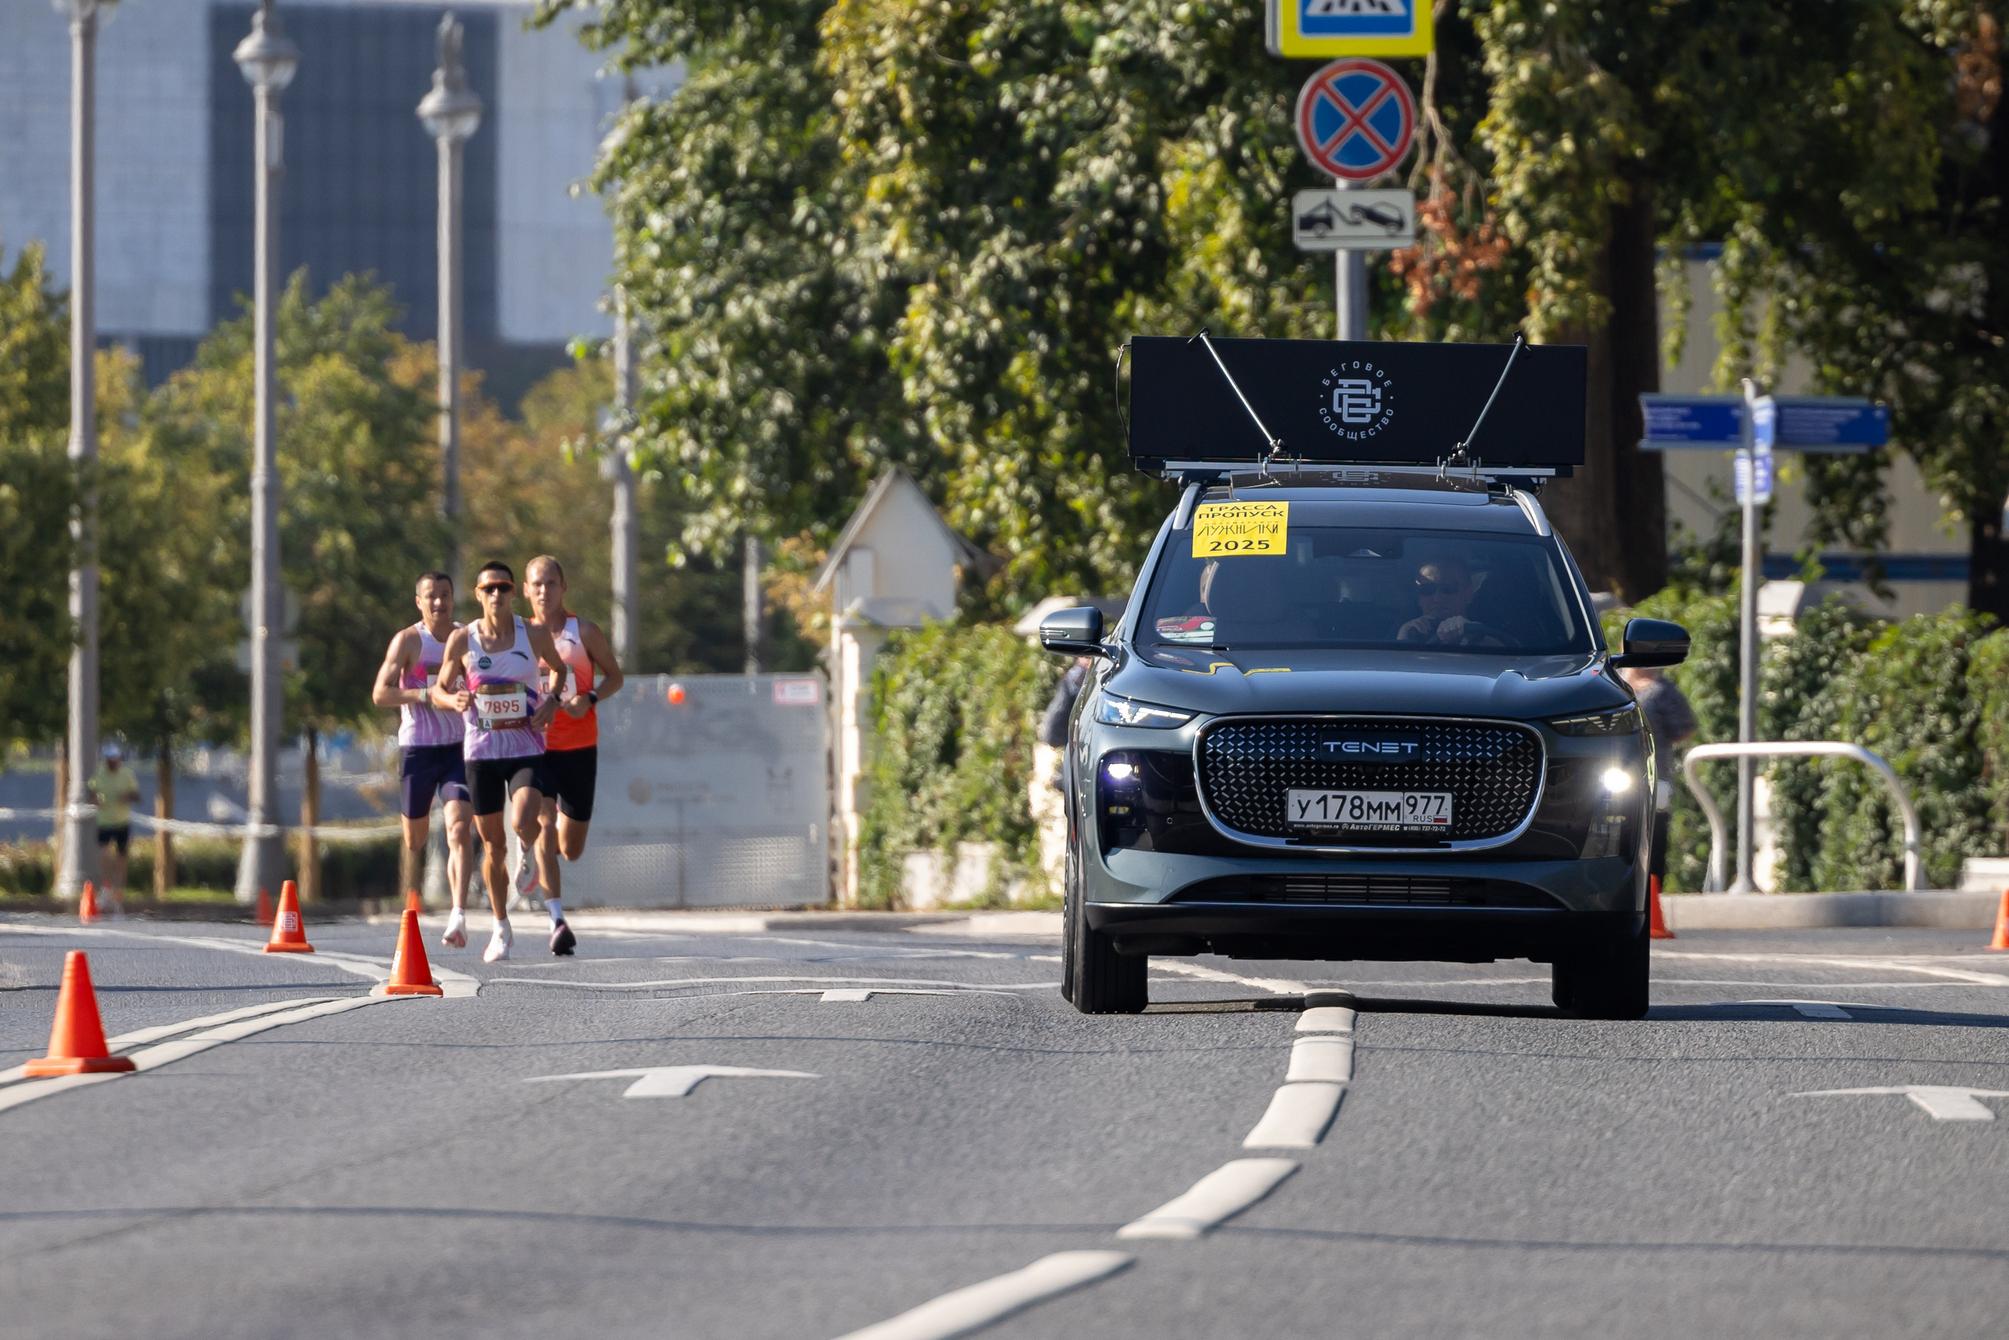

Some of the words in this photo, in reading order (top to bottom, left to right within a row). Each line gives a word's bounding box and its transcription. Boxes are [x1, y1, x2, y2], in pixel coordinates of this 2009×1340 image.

[1322, 361, 1392, 387] БЕГОВОЕ
[1319, 408, 1394, 440] СООБЩЕСТВО
[1207, 504, 1277, 512] ТРАССА
[1199, 511, 1284, 519] ПРОПУСК
[1209, 540, 1270, 551] 2025
[484, 700, 519, 713] 7895
[1323, 741, 1418, 753] TENET
[1406, 795, 1445, 815] 977
[1413, 815, 1433, 823] RUS
